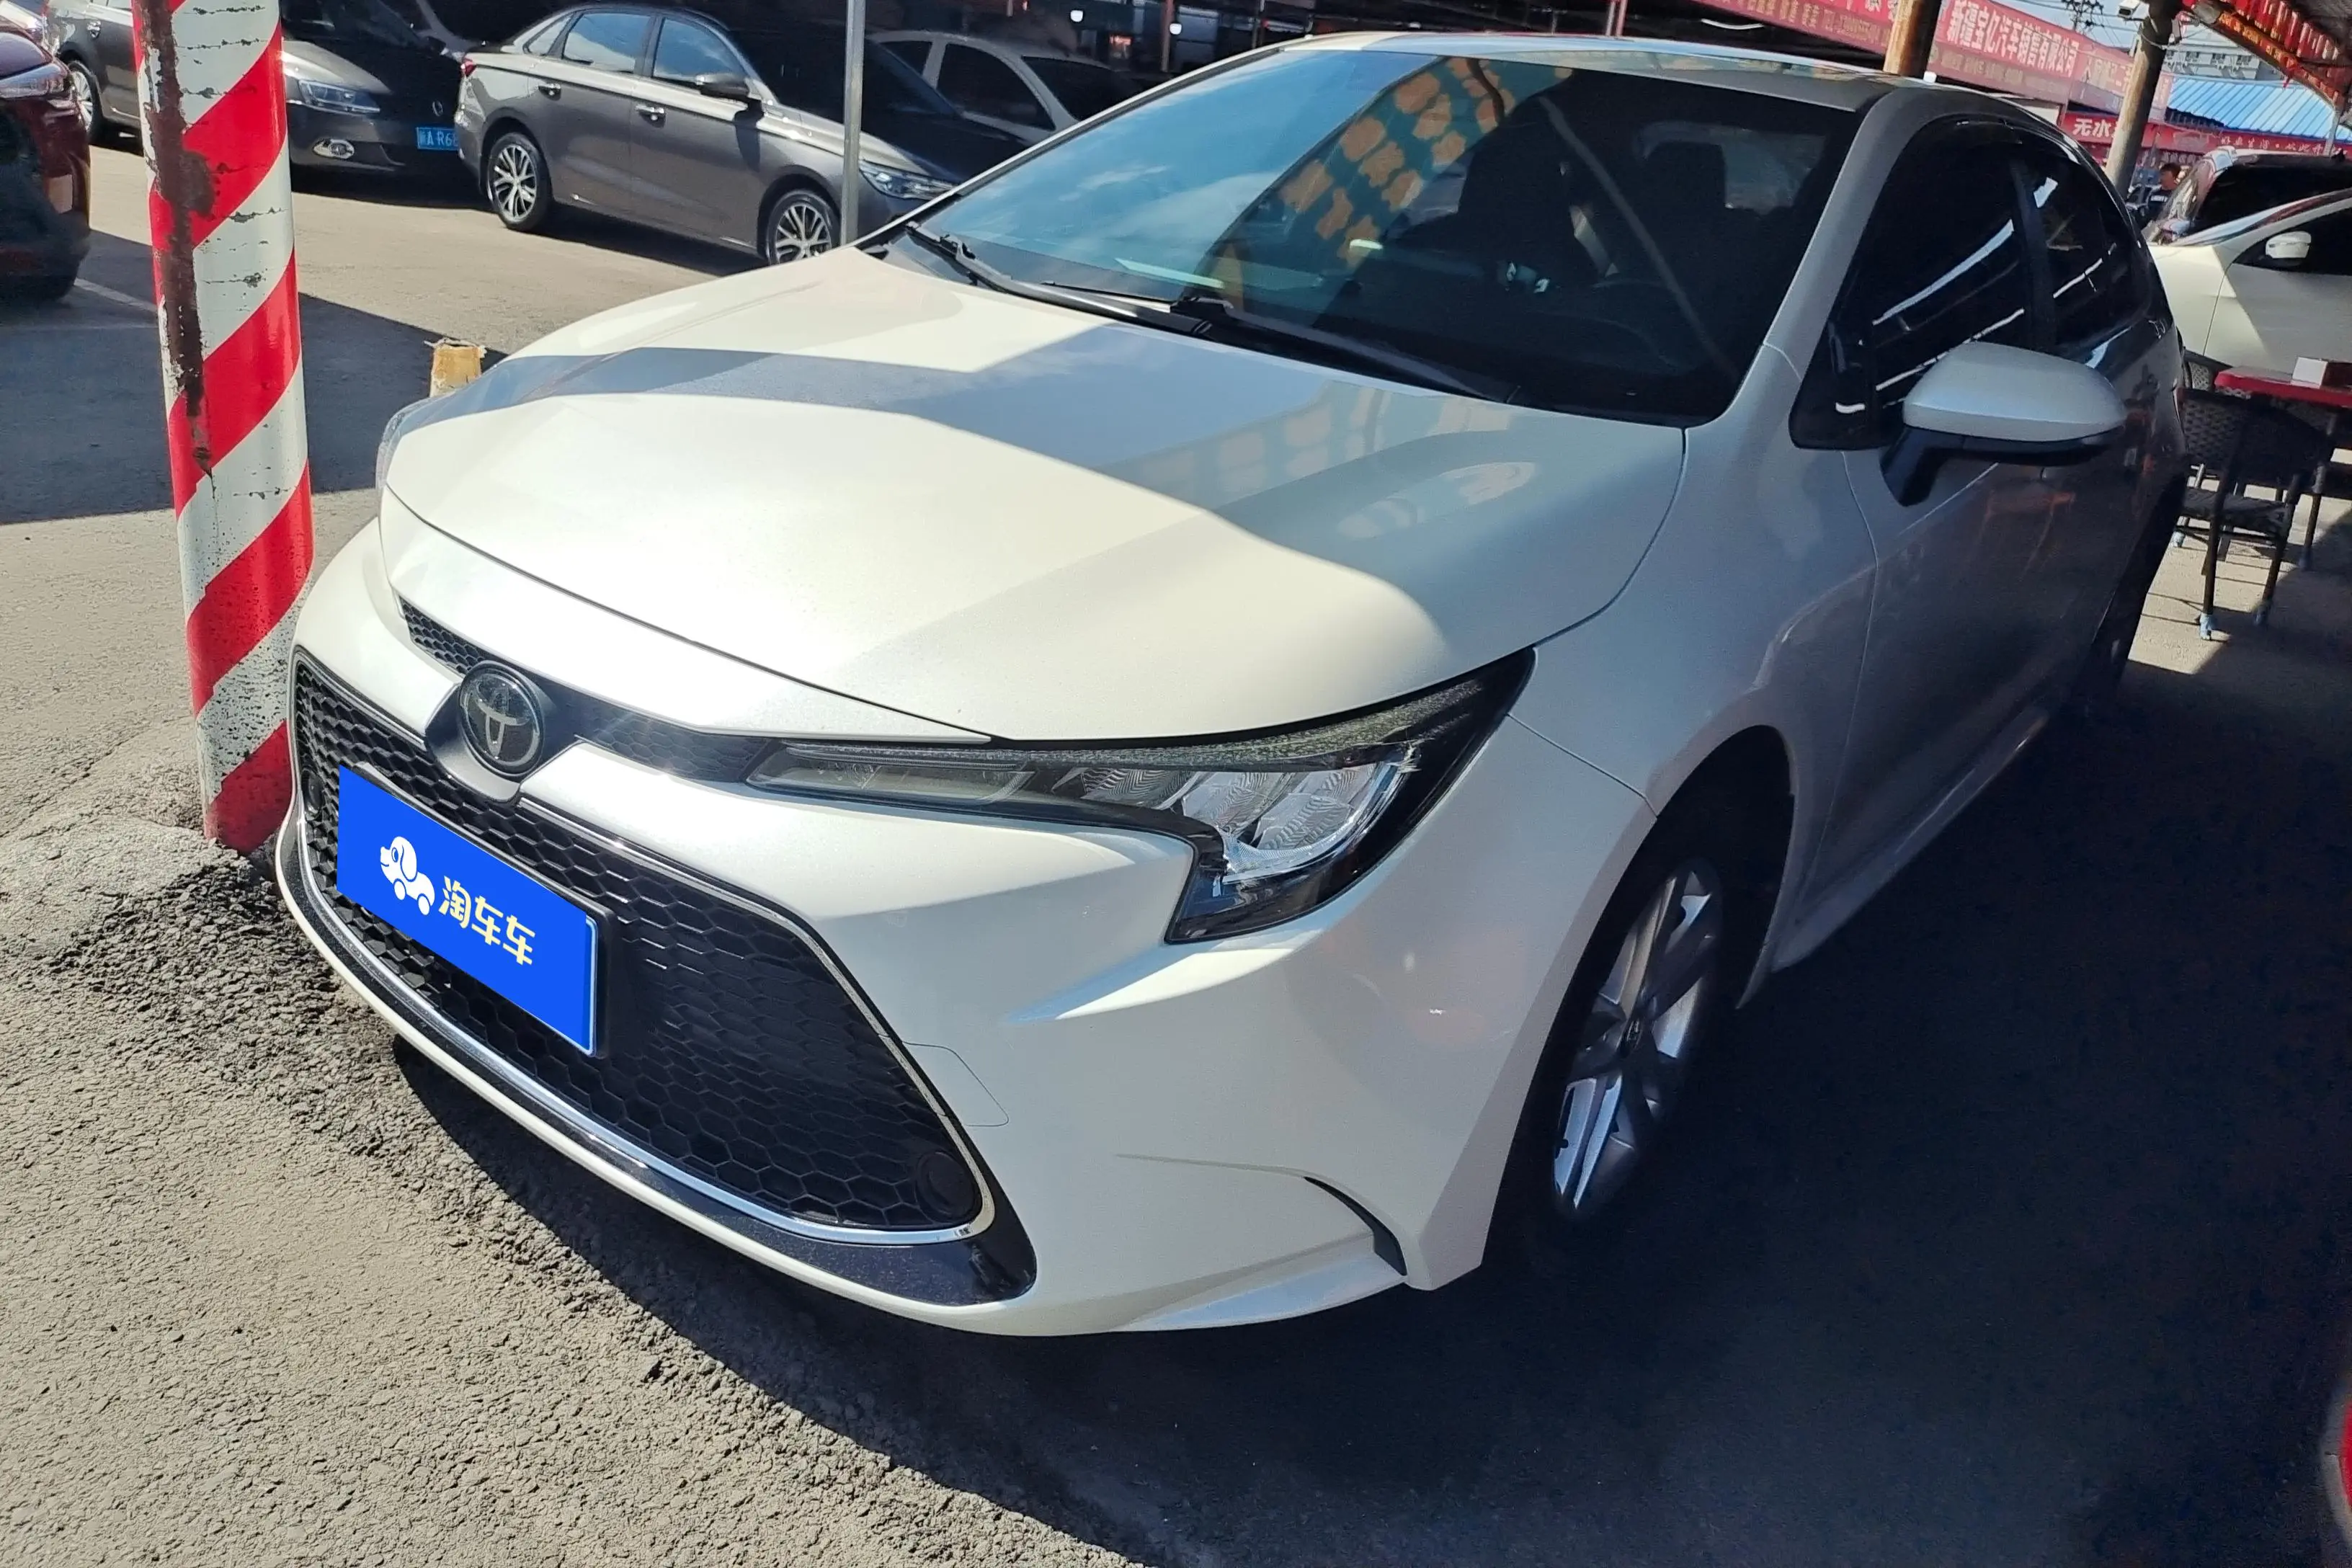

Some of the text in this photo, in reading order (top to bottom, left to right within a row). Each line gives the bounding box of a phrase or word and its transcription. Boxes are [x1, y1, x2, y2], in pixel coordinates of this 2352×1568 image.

[1947, 0, 2080, 78] 新疆宝亿汽车销售有限公司
[2072, 117, 2119, 138] 无水
